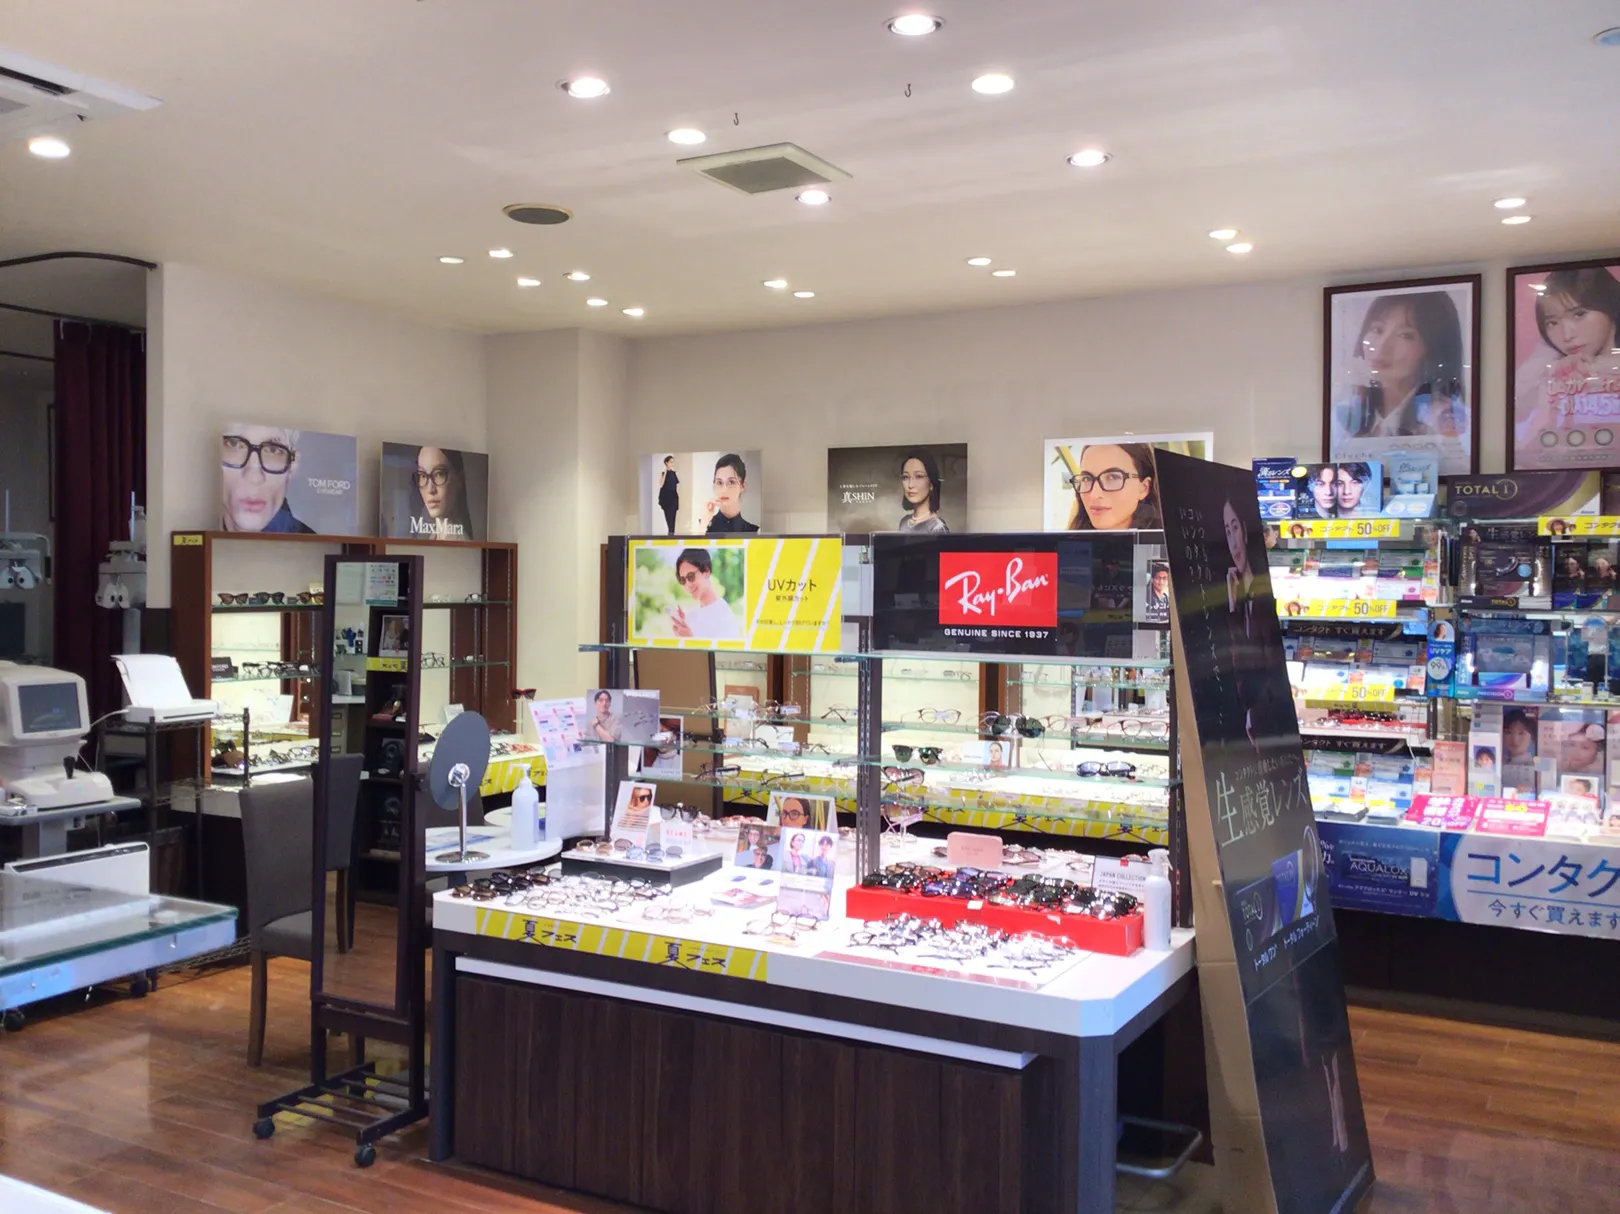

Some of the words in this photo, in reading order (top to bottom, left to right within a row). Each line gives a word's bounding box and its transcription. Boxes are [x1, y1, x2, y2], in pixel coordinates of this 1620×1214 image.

[308, 477, 326, 488] TOM
[327, 479, 350, 490] FORD
[1455, 485, 1498, 495] TOTAL
[767, 579, 817, 592] UVカット
[944, 628, 988, 637] GENUINE
[991, 629, 1022, 638] SINCE
[1025, 631, 1049, 639] 1937
[1293, 624, 1330, 634] コンタクト
[1350, 861, 1408, 876] AQUALOX
[1100, 871, 1116, 879] JAPAN
[1488, 899, 1620, 929] 今すぐ買えます
